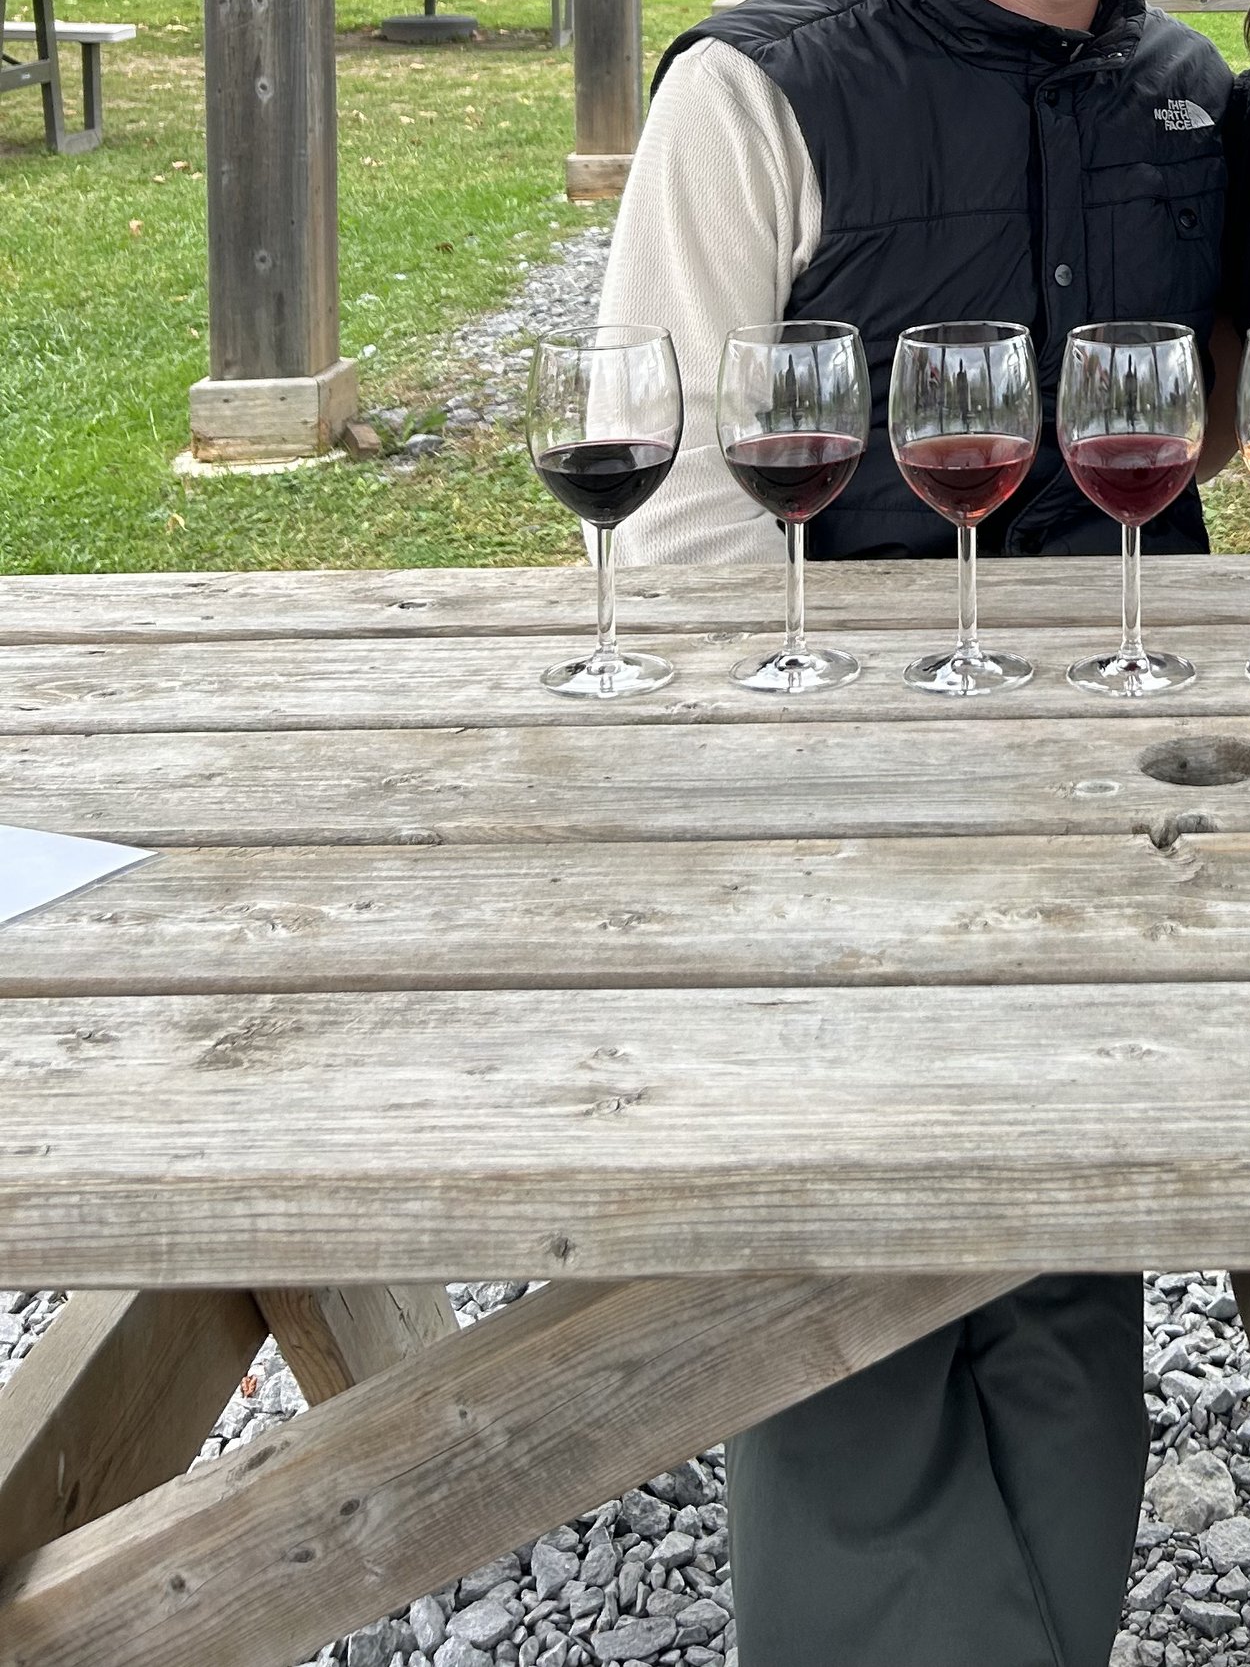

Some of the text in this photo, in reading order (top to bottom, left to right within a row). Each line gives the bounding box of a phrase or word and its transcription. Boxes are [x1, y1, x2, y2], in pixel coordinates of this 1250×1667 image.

[1167, 98, 1186, 110] THE
[1153, 108, 1190, 120] NORTH
[1164, 120, 1193, 131] FACE
